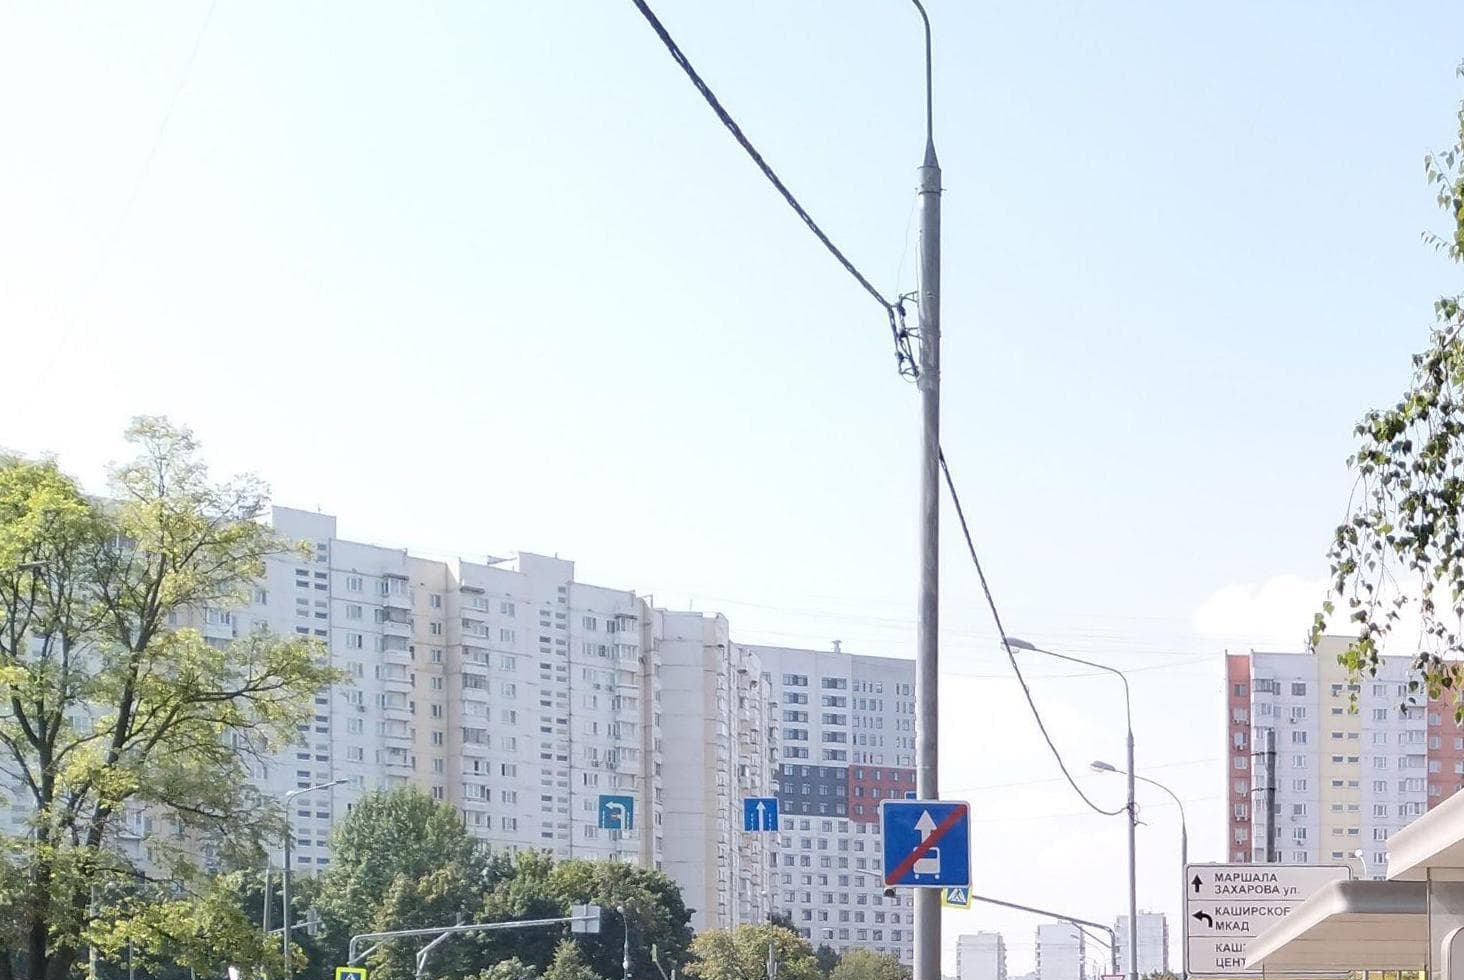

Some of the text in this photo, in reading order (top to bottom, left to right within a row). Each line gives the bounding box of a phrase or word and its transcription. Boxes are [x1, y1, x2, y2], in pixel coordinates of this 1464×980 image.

[1214, 873, 1278, 883] МАРШАЛА
[1214, 884, 1280, 895] ЗАХАРОВА
[1215, 921, 1250, 932] МКАД
[1215, 943, 1246, 953] КАШ
[1215, 957, 1246, 969] ЦЕНТ
